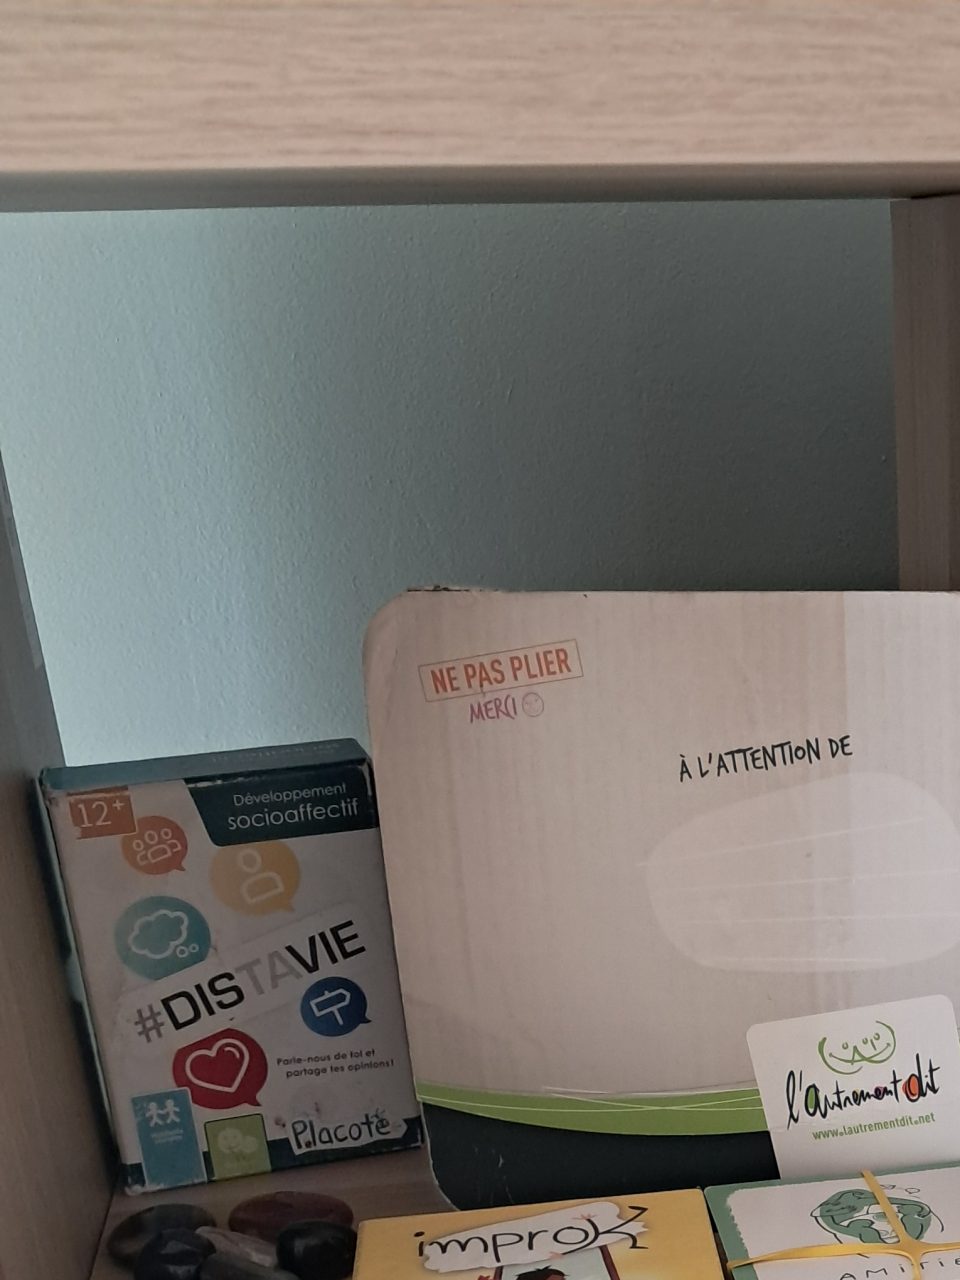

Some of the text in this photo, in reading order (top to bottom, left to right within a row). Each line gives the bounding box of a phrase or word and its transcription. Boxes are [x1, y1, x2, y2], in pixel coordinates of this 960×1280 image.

[430, 647, 572, 695] NE PAS PLIER
[469, 694, 519, 725] MERCI
[678, 735, 854, 783] À L'ATTENTION DE
[233, 782, 347, 808] Développement
[227, 798, 359, 831] socioaffectif
[133, 920, 367, 1045] #DISTAVIE
[286, 1065, 326, 1080] partage
[812, 1112, 936, 1140] www.lautrementdit.net
